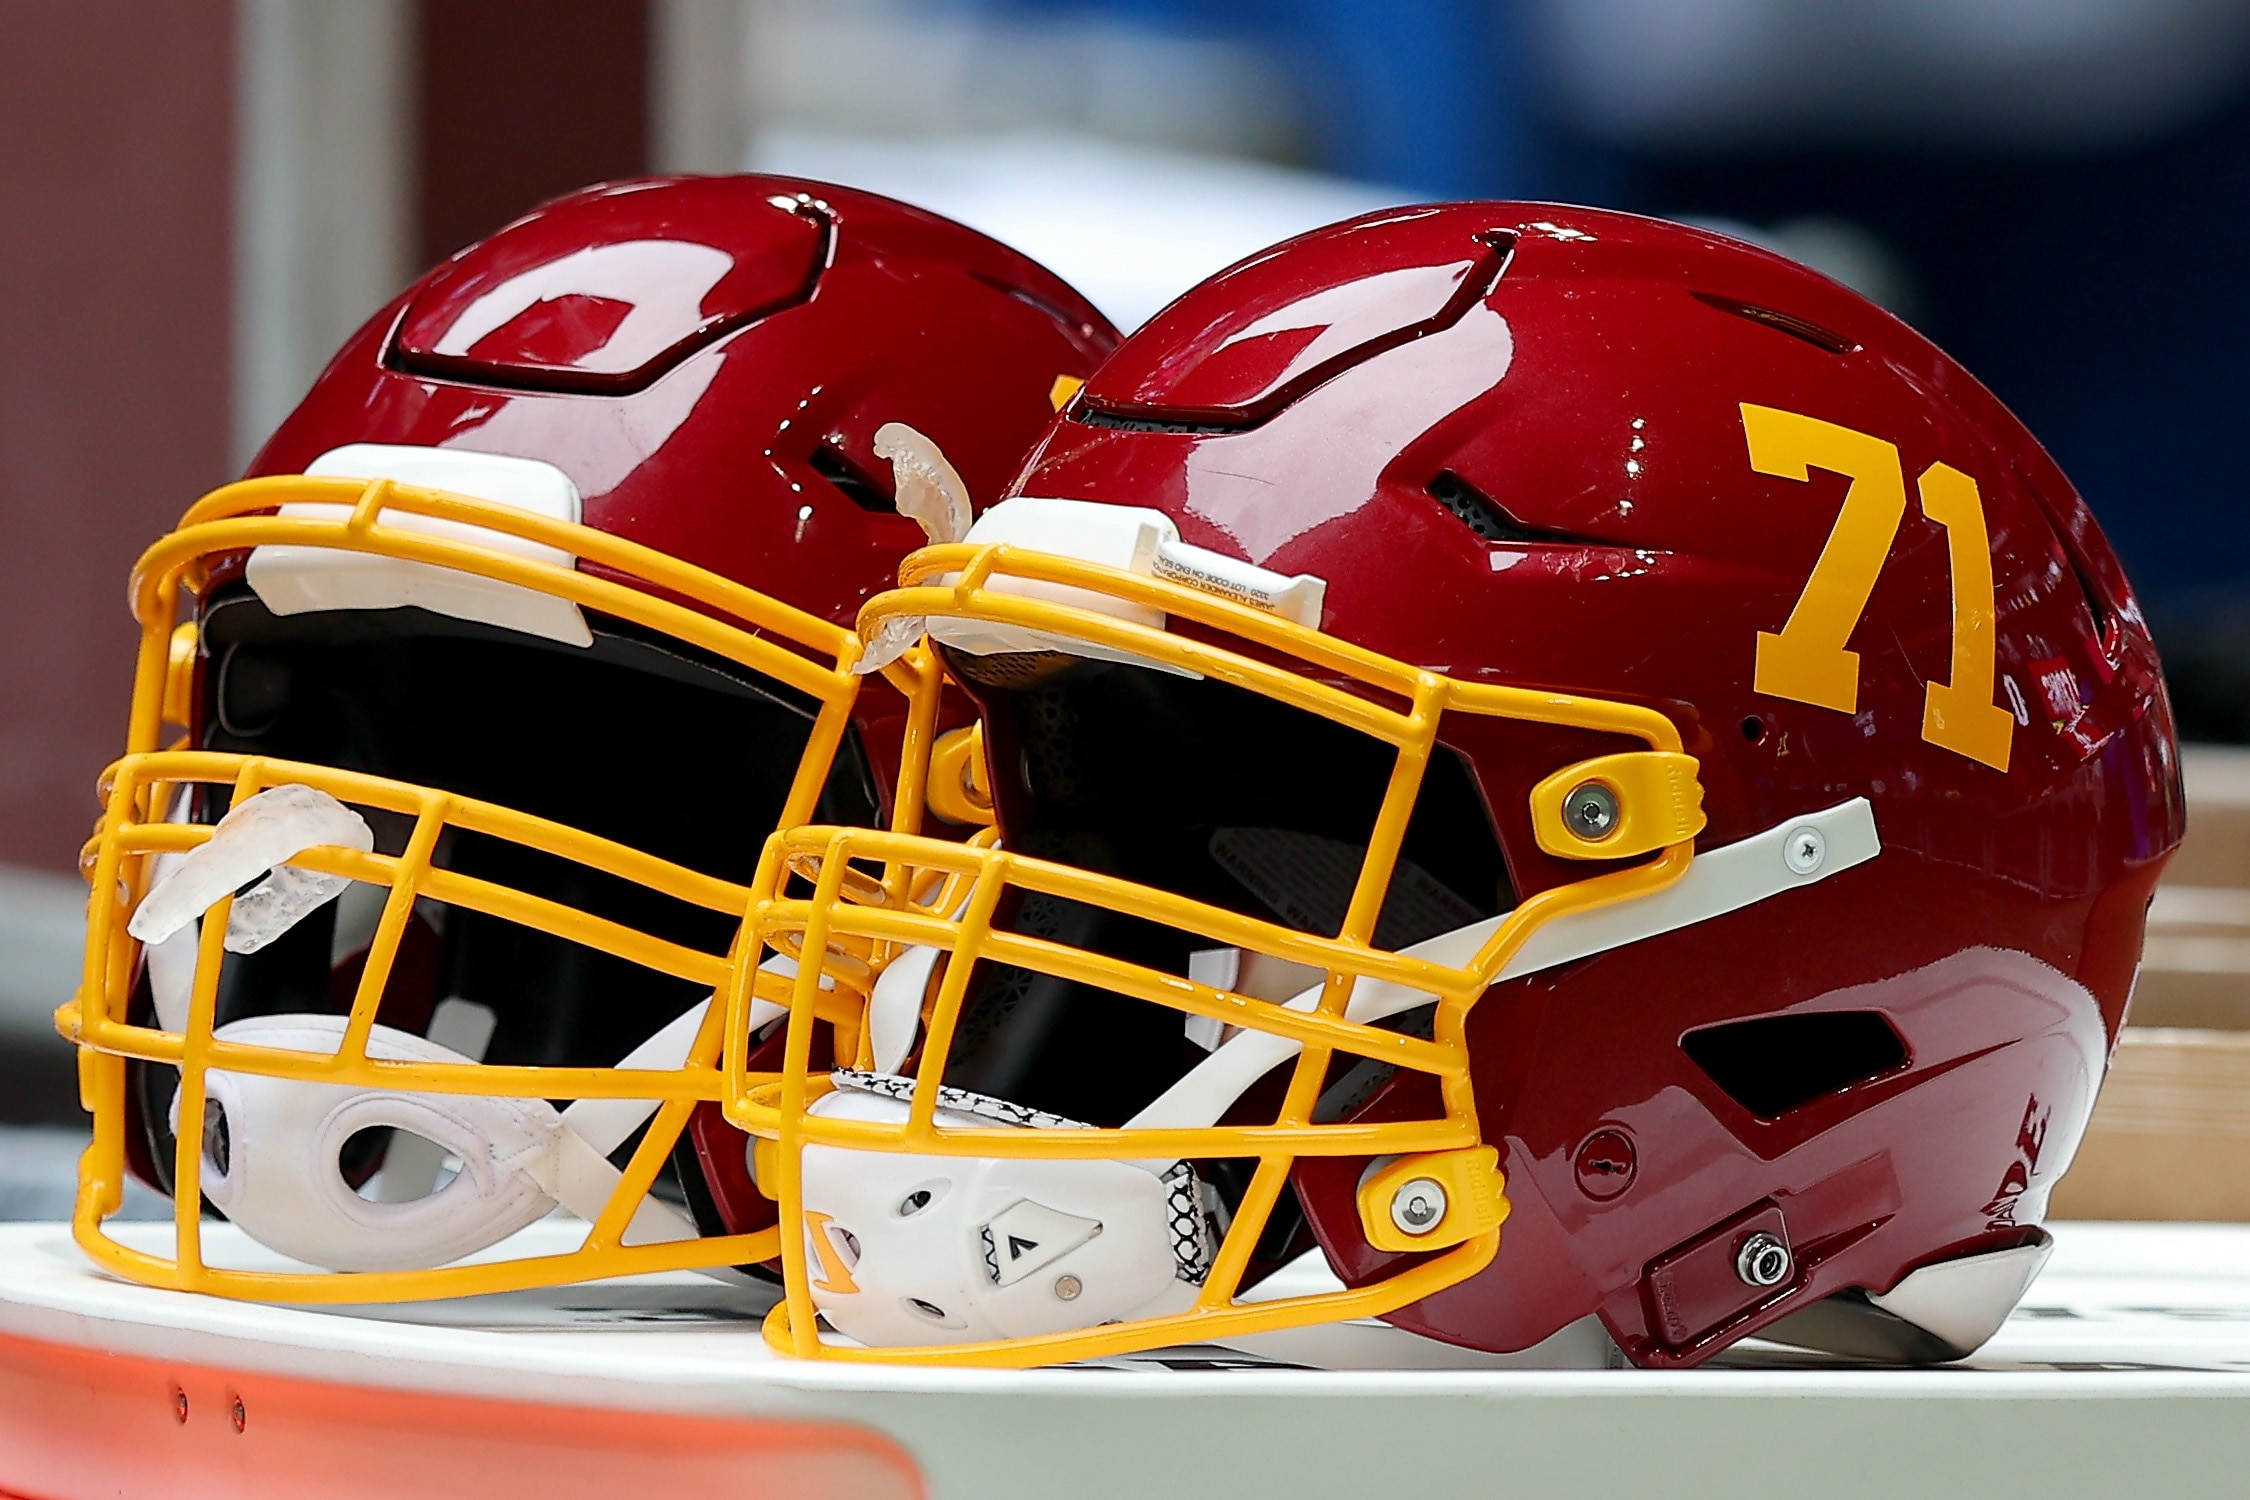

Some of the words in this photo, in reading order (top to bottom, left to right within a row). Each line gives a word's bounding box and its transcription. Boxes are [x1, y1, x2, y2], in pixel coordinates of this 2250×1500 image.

[1192, 569, 1206, 579] ON
[1206, 573, 1230, 587] CODE
[1231, 582, 1247, 593] LOT
[1739, 401, 2014, 773] 71
[1250, 598, 1276, 610] JAMES
